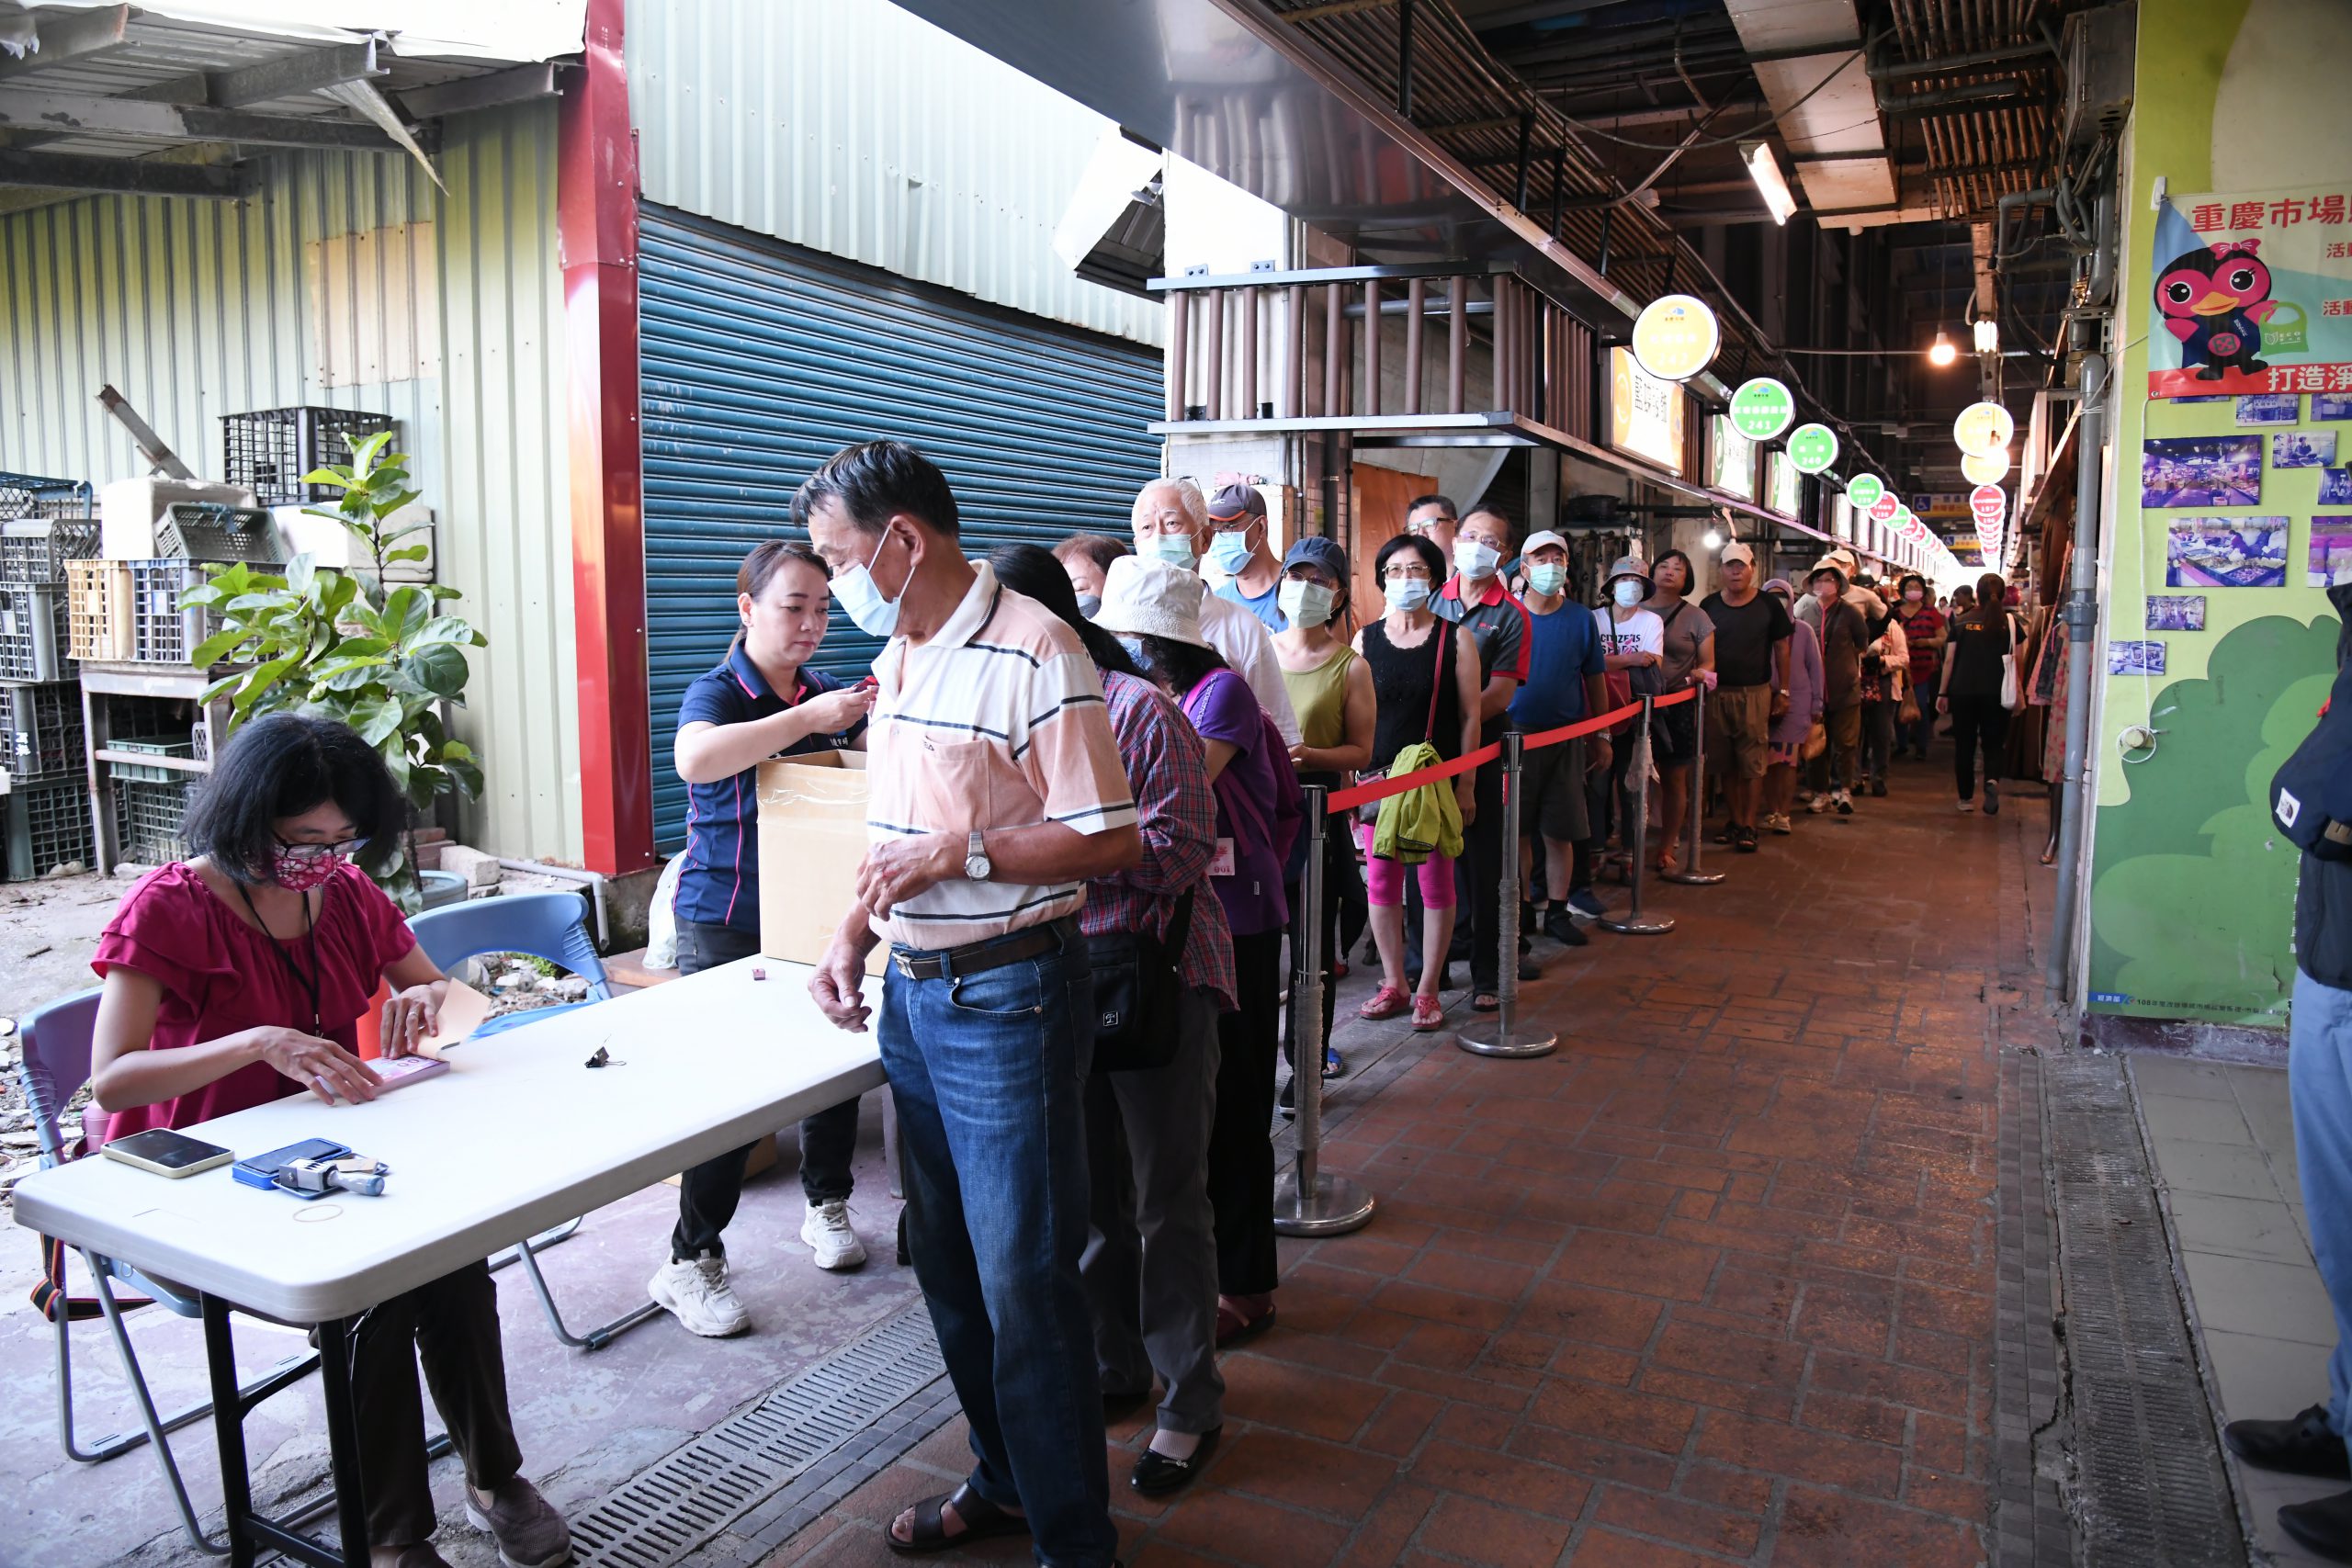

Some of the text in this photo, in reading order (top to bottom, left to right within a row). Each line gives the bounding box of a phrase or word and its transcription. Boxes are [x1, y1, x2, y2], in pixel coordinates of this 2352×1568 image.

[2191, 195, 2352, 232] 重慶市場
[1747, 421, 1771, 430] 241
